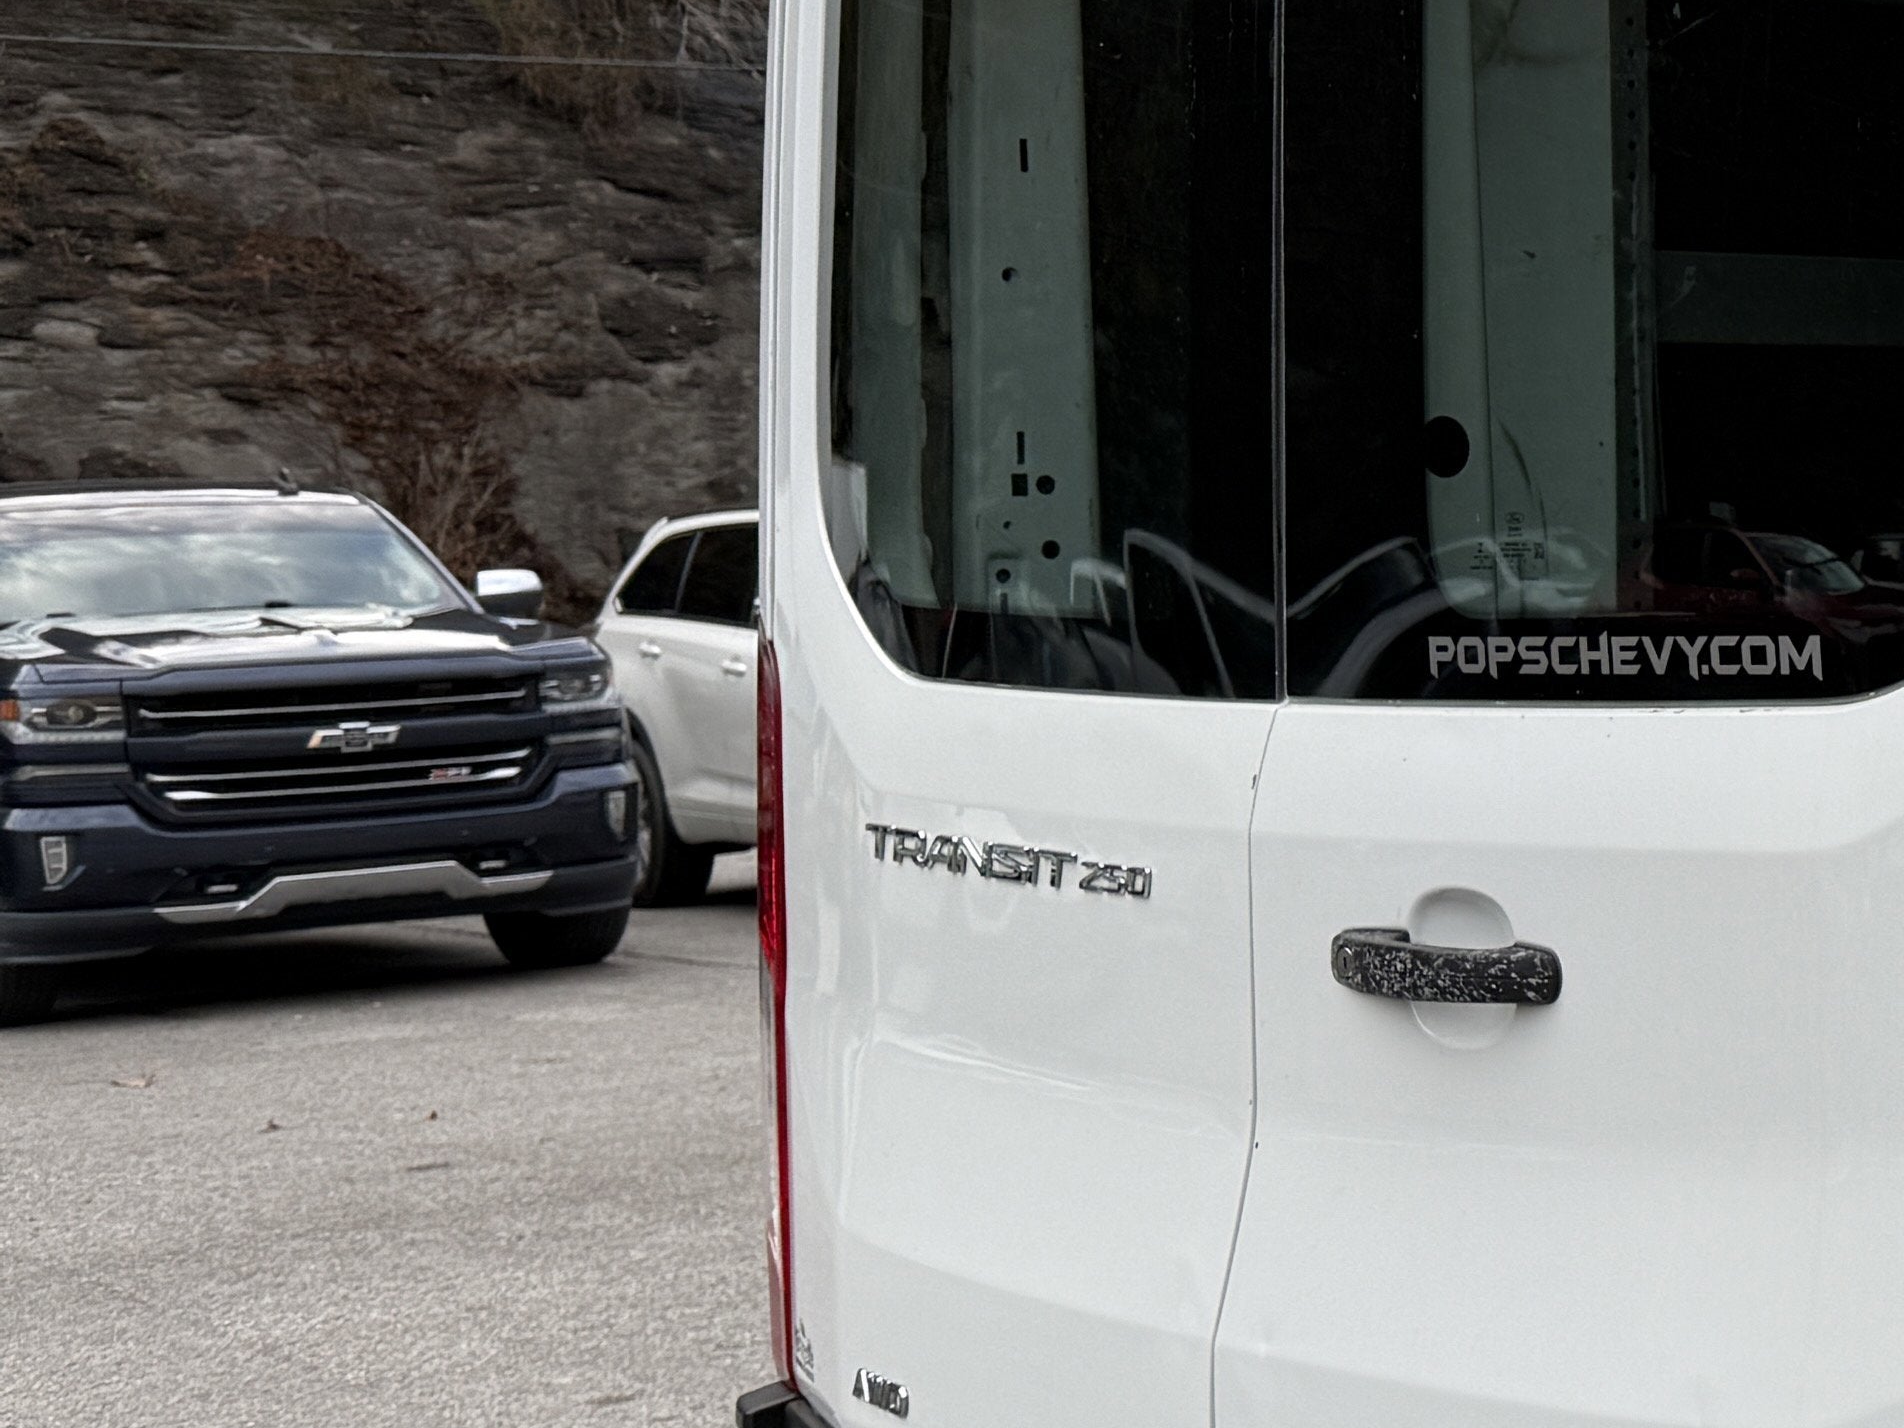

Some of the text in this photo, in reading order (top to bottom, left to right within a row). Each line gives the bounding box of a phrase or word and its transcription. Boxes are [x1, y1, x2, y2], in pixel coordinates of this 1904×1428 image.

[1427, 631, 1824, 681] POPSCHEVY.COM
[865, 822, 1152, 900] TRANSIT 250
